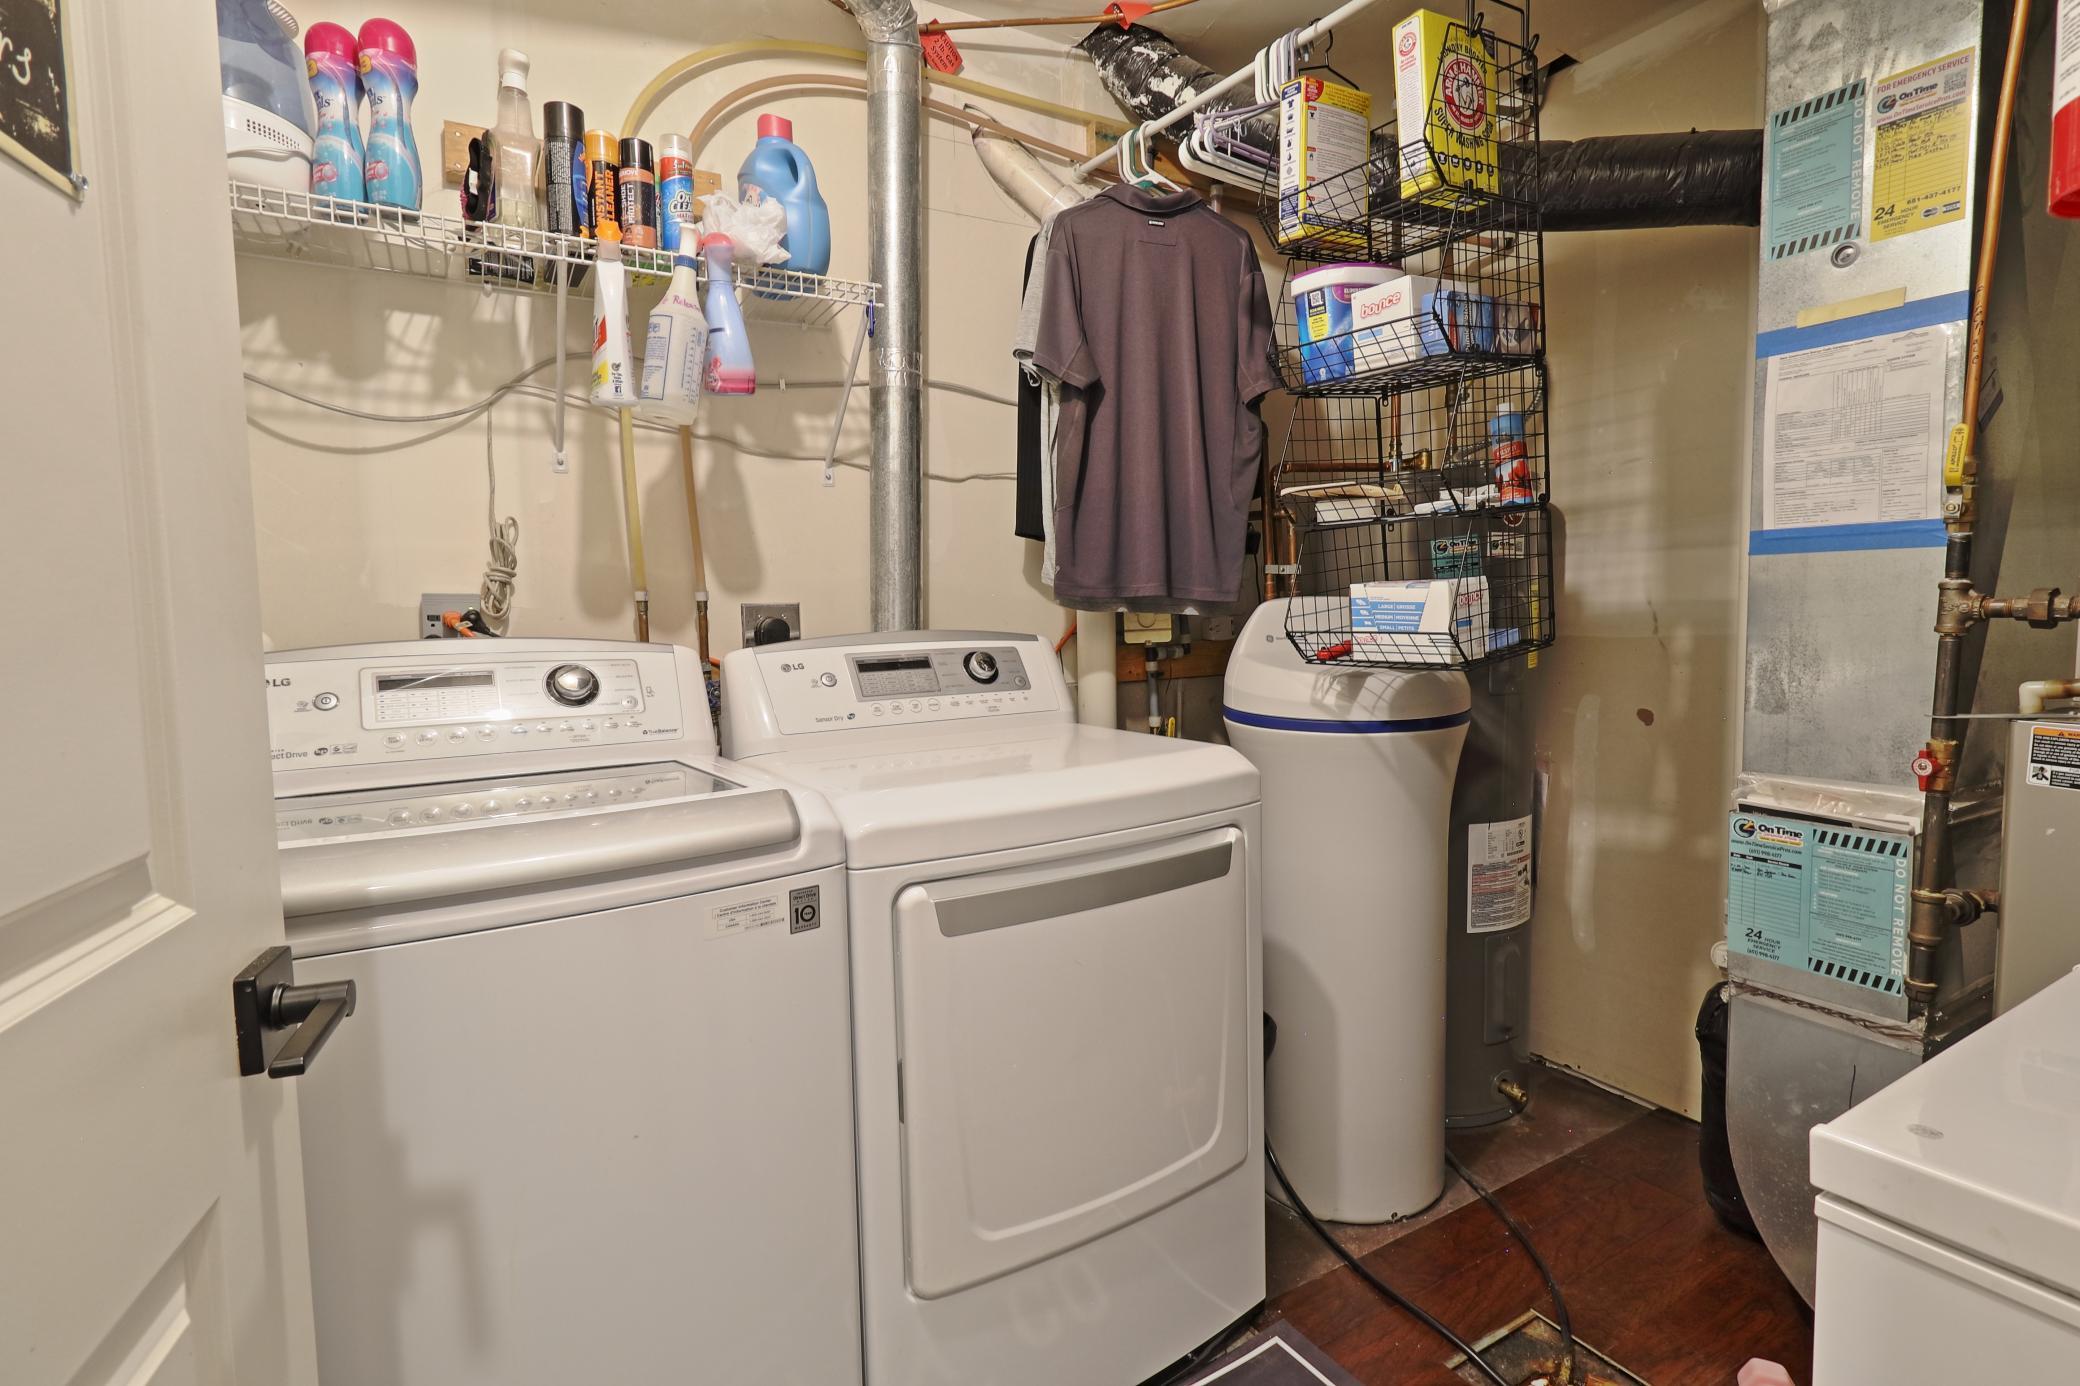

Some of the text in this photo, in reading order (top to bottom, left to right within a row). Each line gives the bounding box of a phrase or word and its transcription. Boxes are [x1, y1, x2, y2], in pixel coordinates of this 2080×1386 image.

[940, 34, 958, 61] CAUTION
[1877, 55, 1970, 94] FOR EMERGENCY SERVICE
[1899, 83, 1938, 100] On Time
[1851, 97, 1864, 221] DO NOT REMOVE
[626, 184, 636, 224] PROTECT
[1874, 203, 1895, 221] 24
[1360, 292, 1401, 319] bounce
[792, 663, 805, 671] LG
[272, 678, 291, 687] LG
[285, 750, 308, 760] Drive
[1758, 824, 1803, 839] On Time
[794, 904, 816, 925] 10
[1891, 859, 1907, 977] DO NOT REMOVE
[1745, 927, 1762, 939] 24
